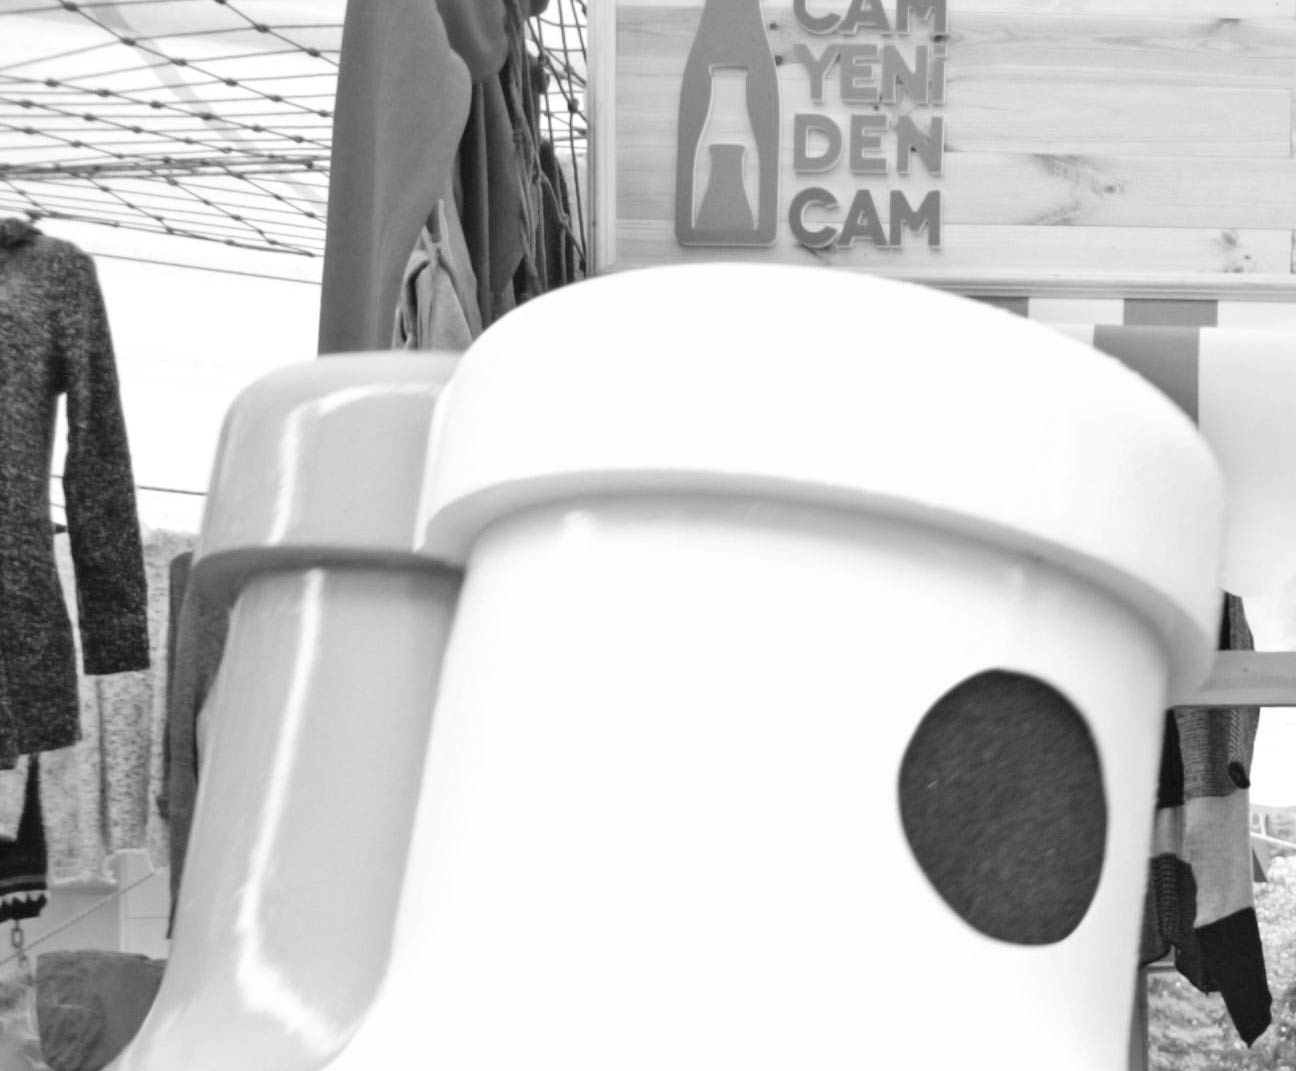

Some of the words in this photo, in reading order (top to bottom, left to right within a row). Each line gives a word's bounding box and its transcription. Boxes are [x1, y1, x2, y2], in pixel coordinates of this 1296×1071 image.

[793, 0, 948, 36] CAM
[792, 113, 944, 176] DEN
[788, 187, 942, 250] CAM
